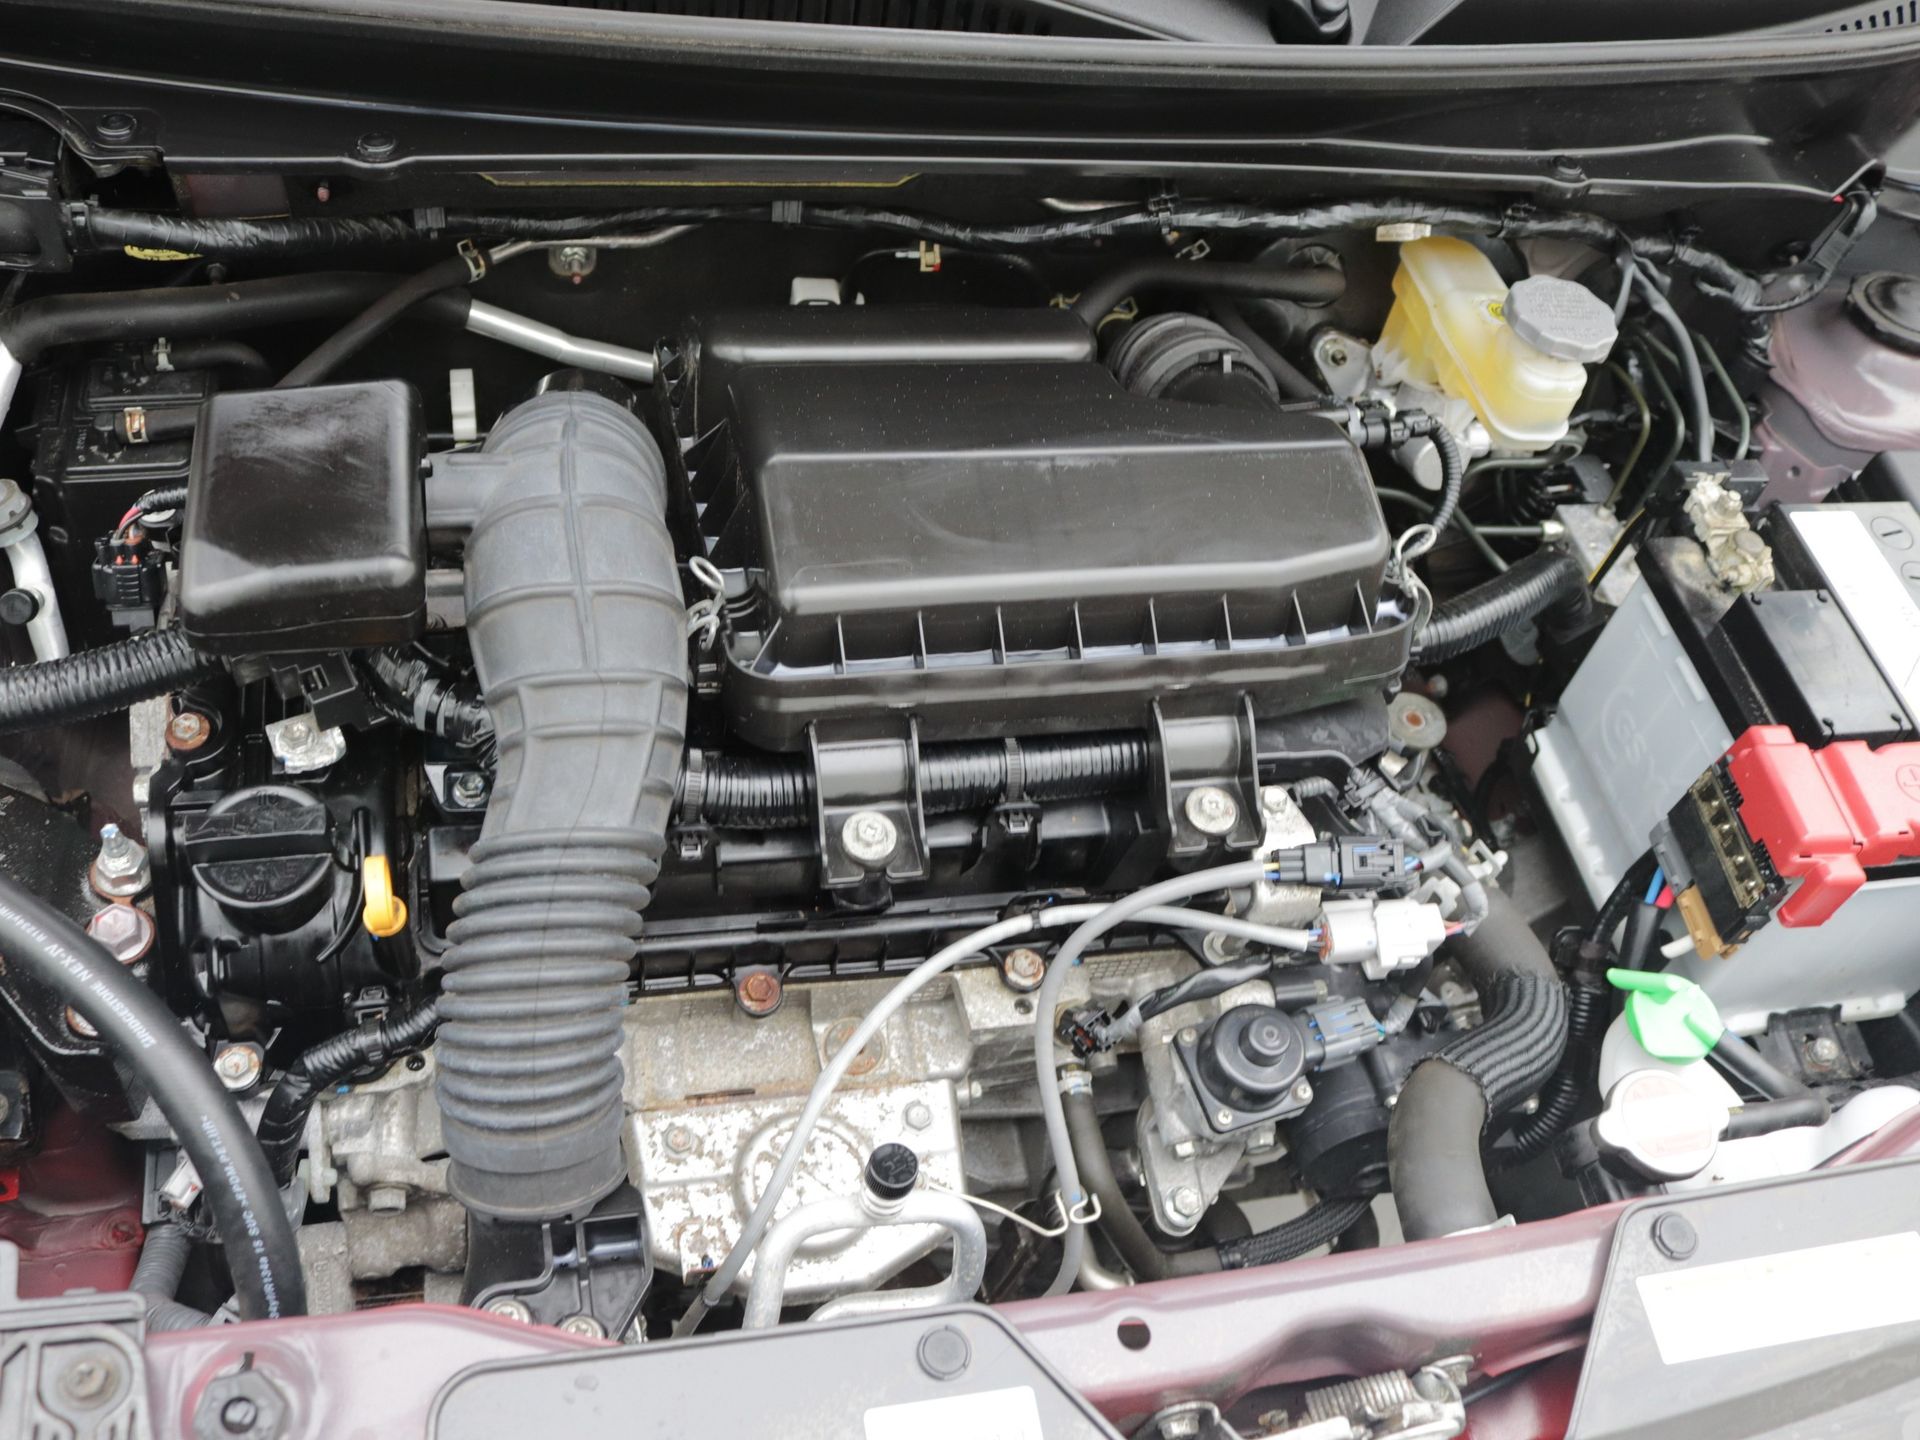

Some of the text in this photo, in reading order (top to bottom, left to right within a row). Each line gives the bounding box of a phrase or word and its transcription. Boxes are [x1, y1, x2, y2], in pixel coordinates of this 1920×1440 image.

[1614, 709, 1648, 766] GS
[0, 905, 157, 1049] BRIDGESTONE NEX-IV R1234yf/R
[242, 1210, 260, 1237] SUC
